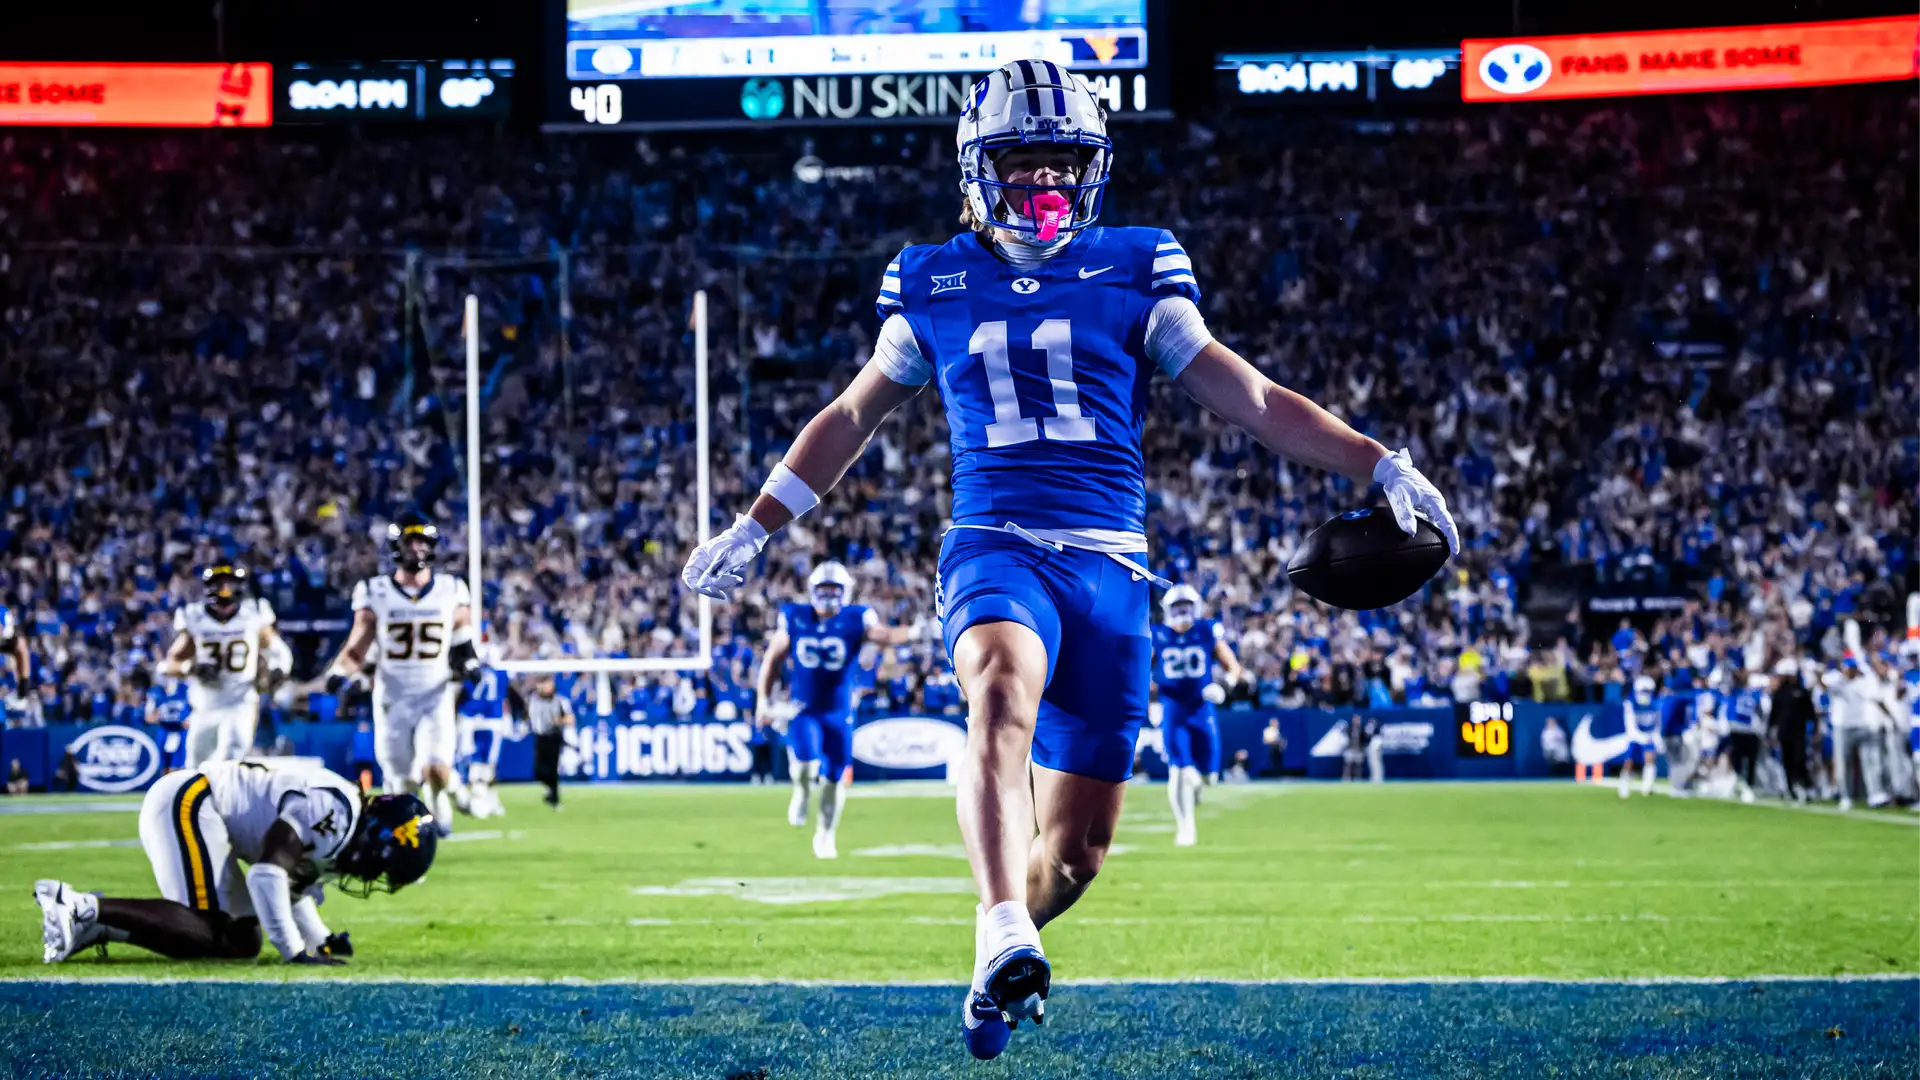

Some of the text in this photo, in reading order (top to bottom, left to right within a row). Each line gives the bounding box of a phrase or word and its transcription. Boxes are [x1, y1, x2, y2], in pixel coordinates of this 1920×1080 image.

[1309, 61, 1358, 91] PM
[1560, 44, 1802, 76] FANS MAKE SOME
[28, 82, 105, 104] SOME
[359, 79, 408, 109] PM
[570, 84, 622, 124] 40
[793, 74, 971, 119] NU SKIN
[1016, 280, 1035, 292] Y
[969, 318, 1097, 448] 11
[387, 622, 443, 660] 35
[796, 635, 846, 671] 63
[1161, 646, 1206, 679] 20
[1462, 719, 1508, 755] 40
